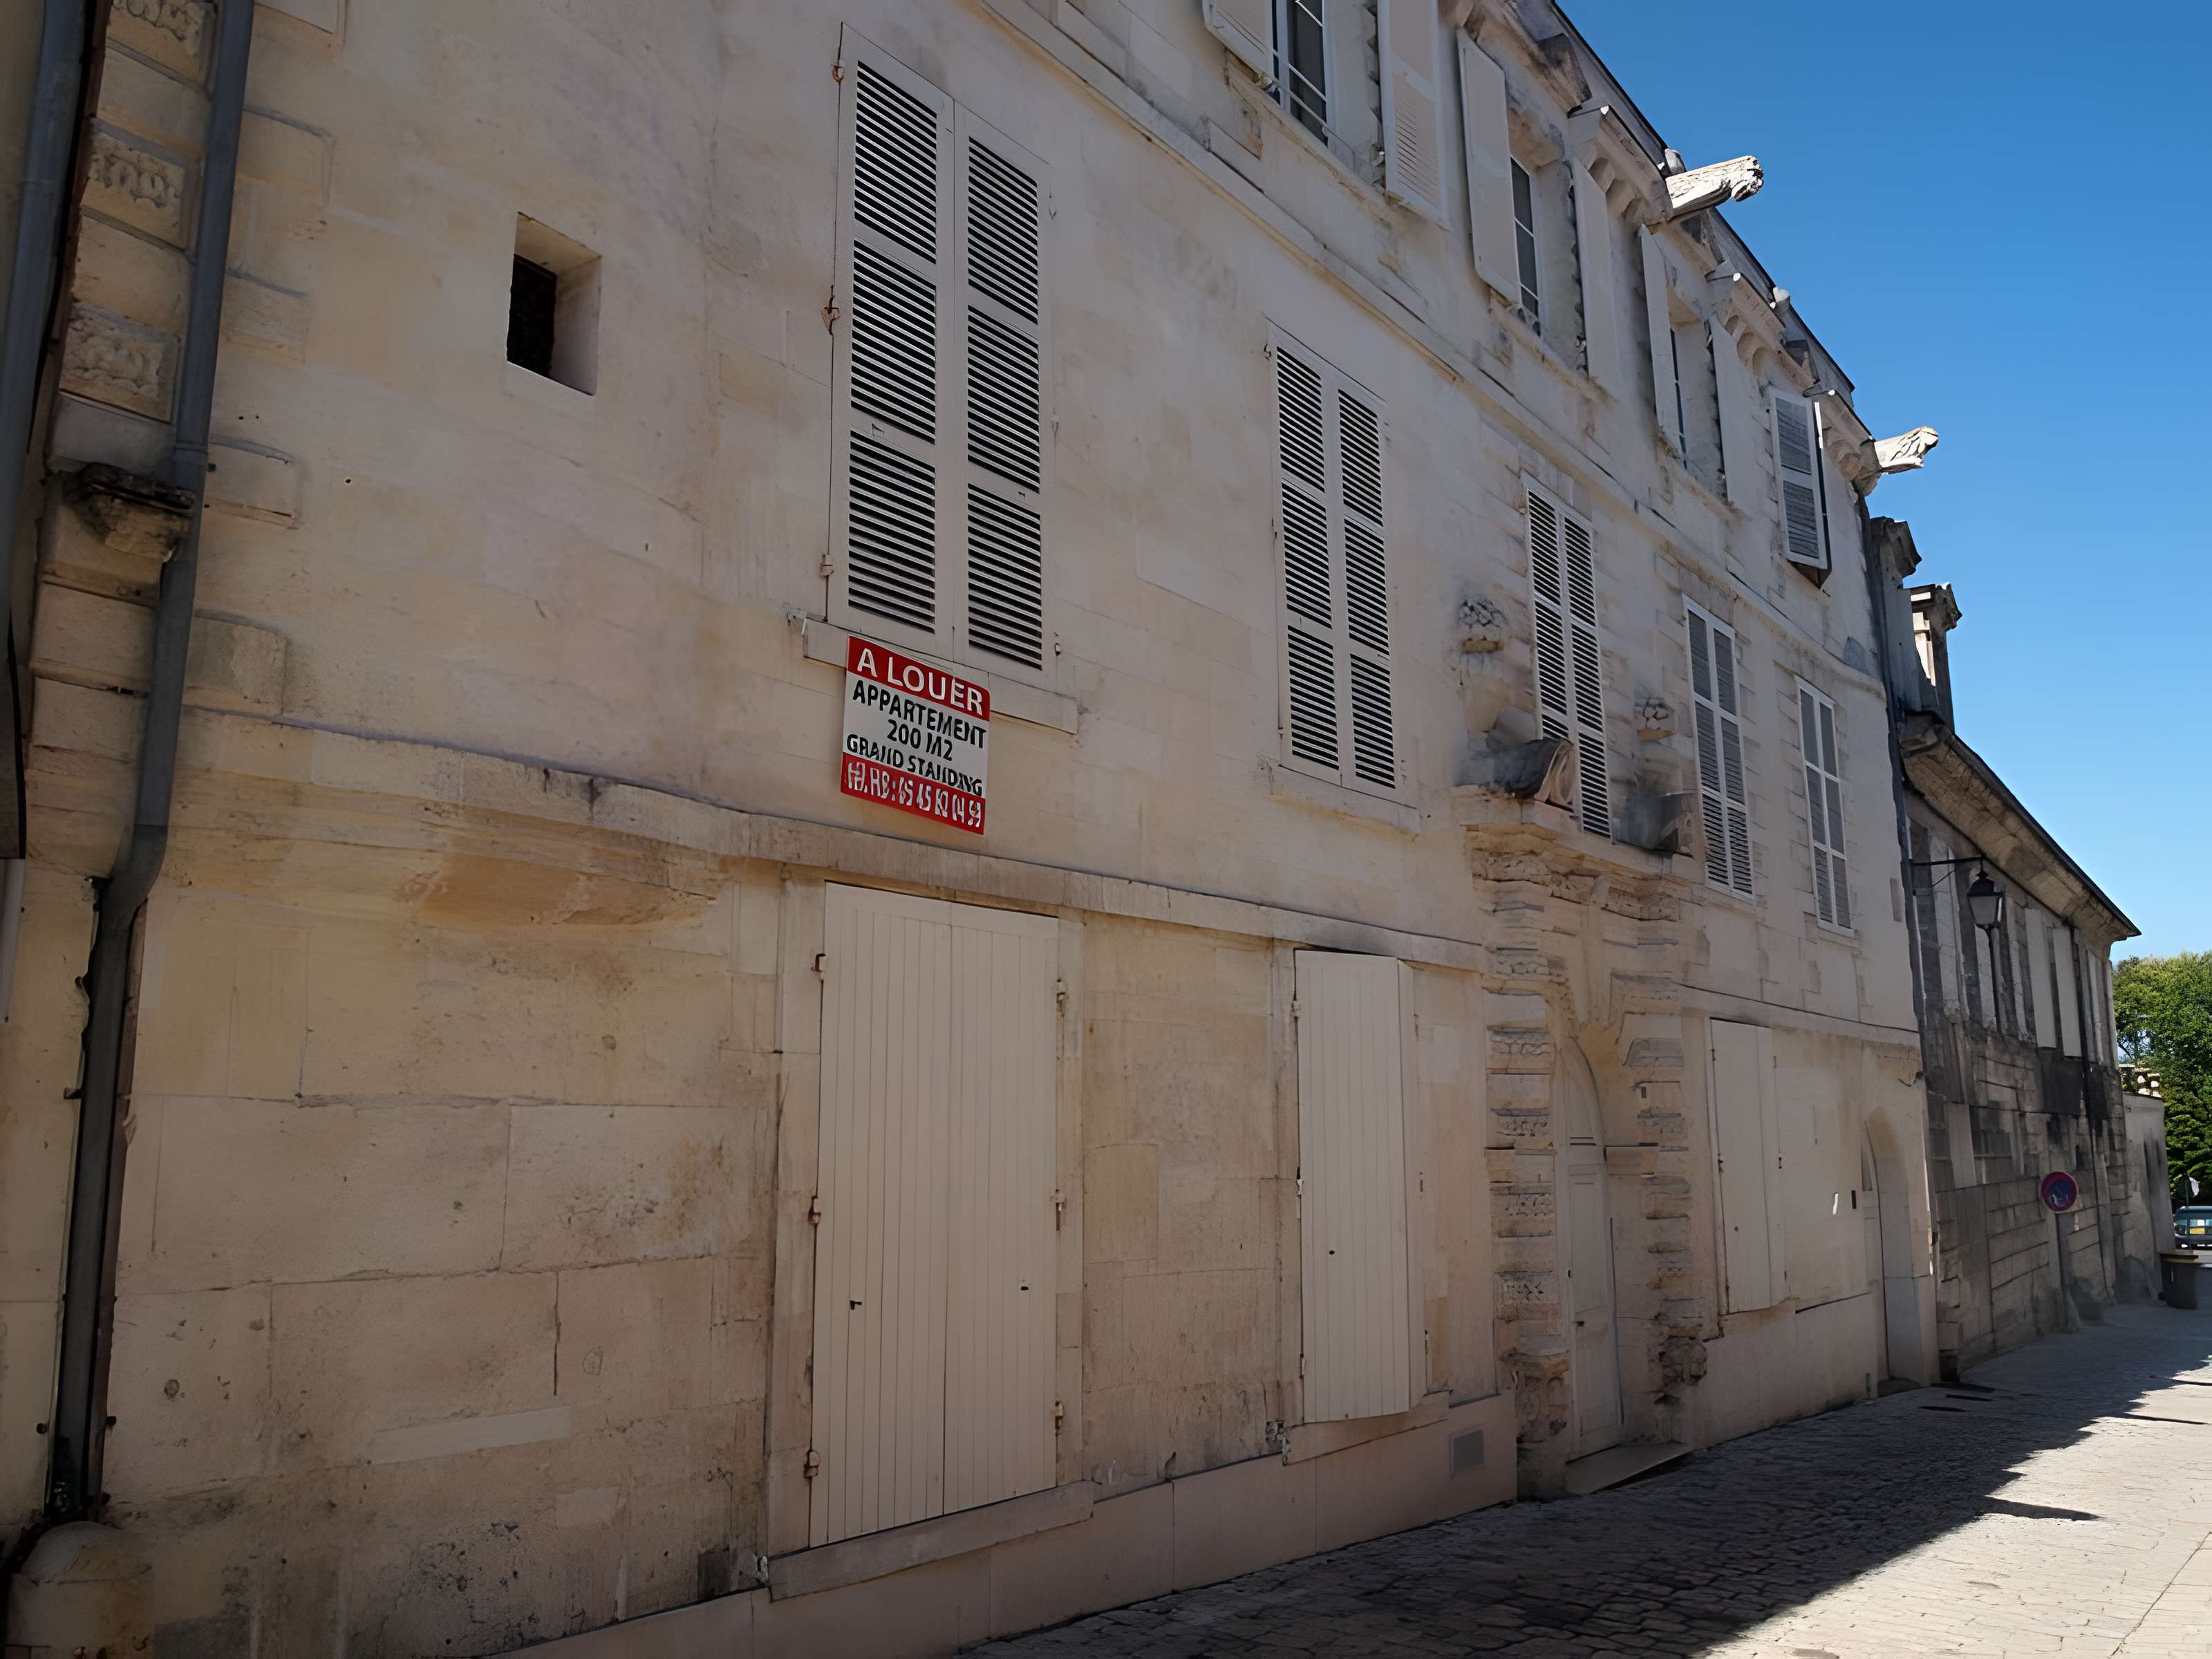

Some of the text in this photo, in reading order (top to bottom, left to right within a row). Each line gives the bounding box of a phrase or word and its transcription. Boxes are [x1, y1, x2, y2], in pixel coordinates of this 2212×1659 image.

[852, 679, 987, 749] APPARTEMENT
[856, 648, 983, 716] A LOUER
[847, 733, 903, 768] GRAND
[906, 755, 983, 796] STANDING
[887, 718, 953, 761] 200 M2
